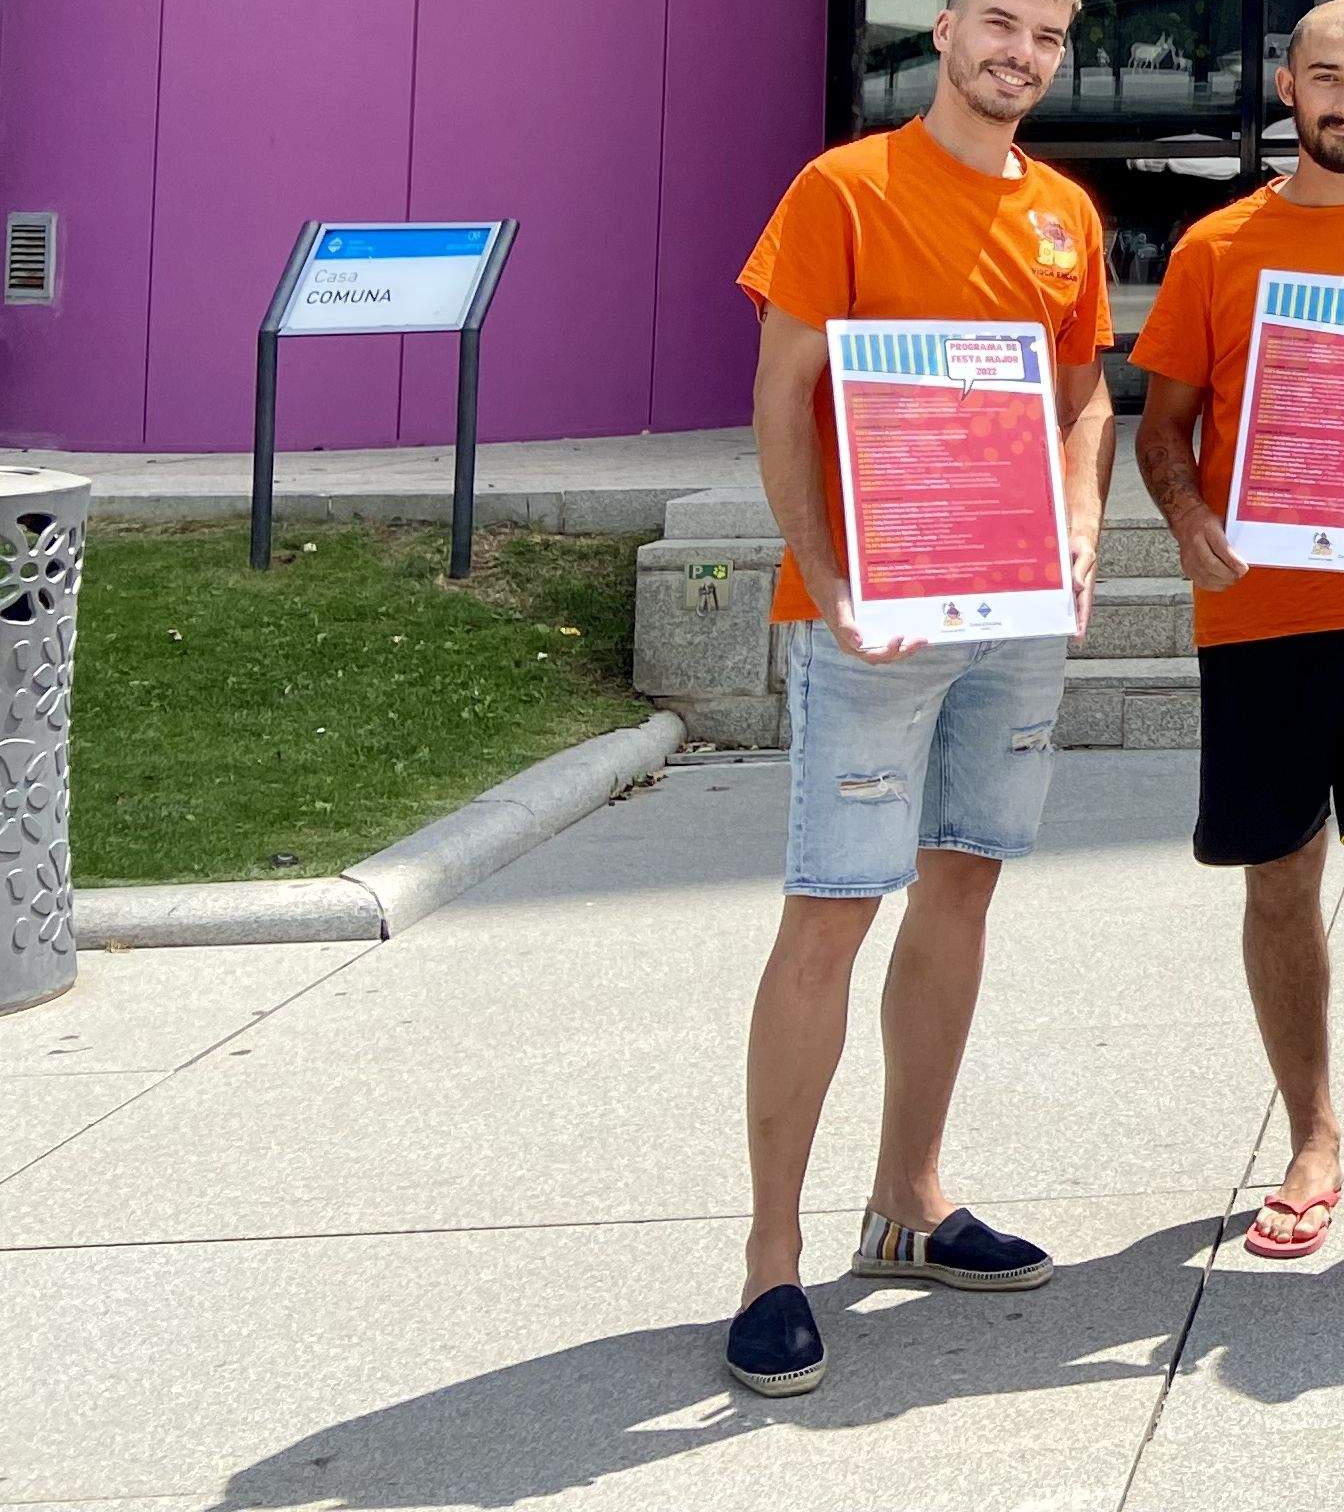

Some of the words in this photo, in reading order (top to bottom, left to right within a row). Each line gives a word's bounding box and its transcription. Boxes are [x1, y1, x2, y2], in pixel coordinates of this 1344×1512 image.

[314, 269, 358, 284] Casa
[306, 289, 392, 305] COMUNA
[692, 565, 704, 579] P
